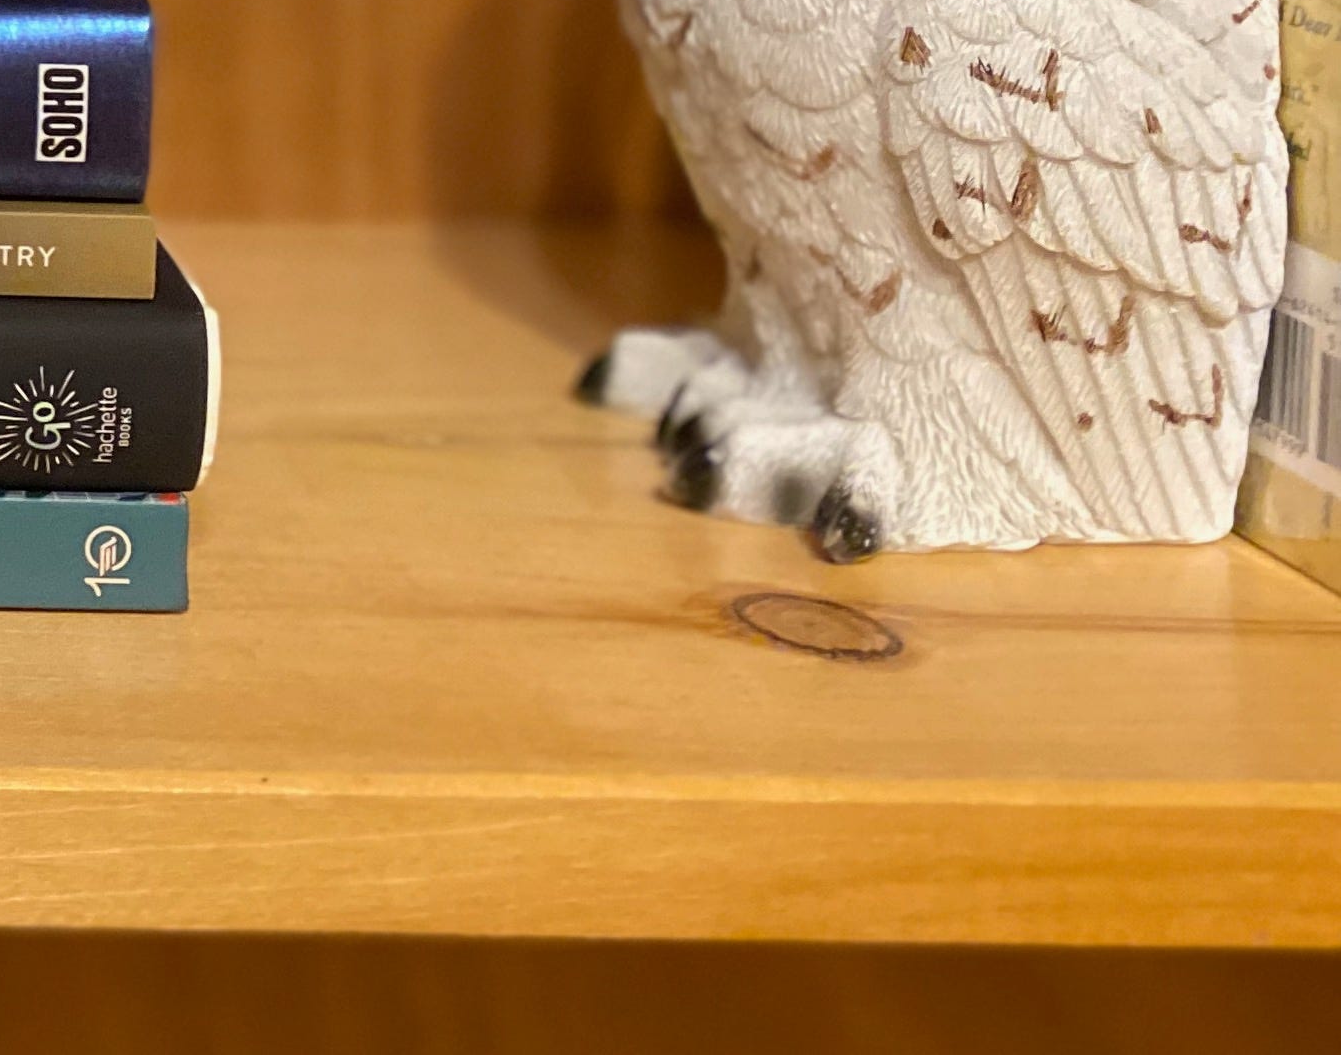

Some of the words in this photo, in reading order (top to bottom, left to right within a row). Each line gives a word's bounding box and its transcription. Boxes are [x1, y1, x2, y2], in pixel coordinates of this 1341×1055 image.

[40, 68, 85, 158] SOHO
[93, 387, 117, 463] hachette
[118, 407, 133, 447] BOOKS
